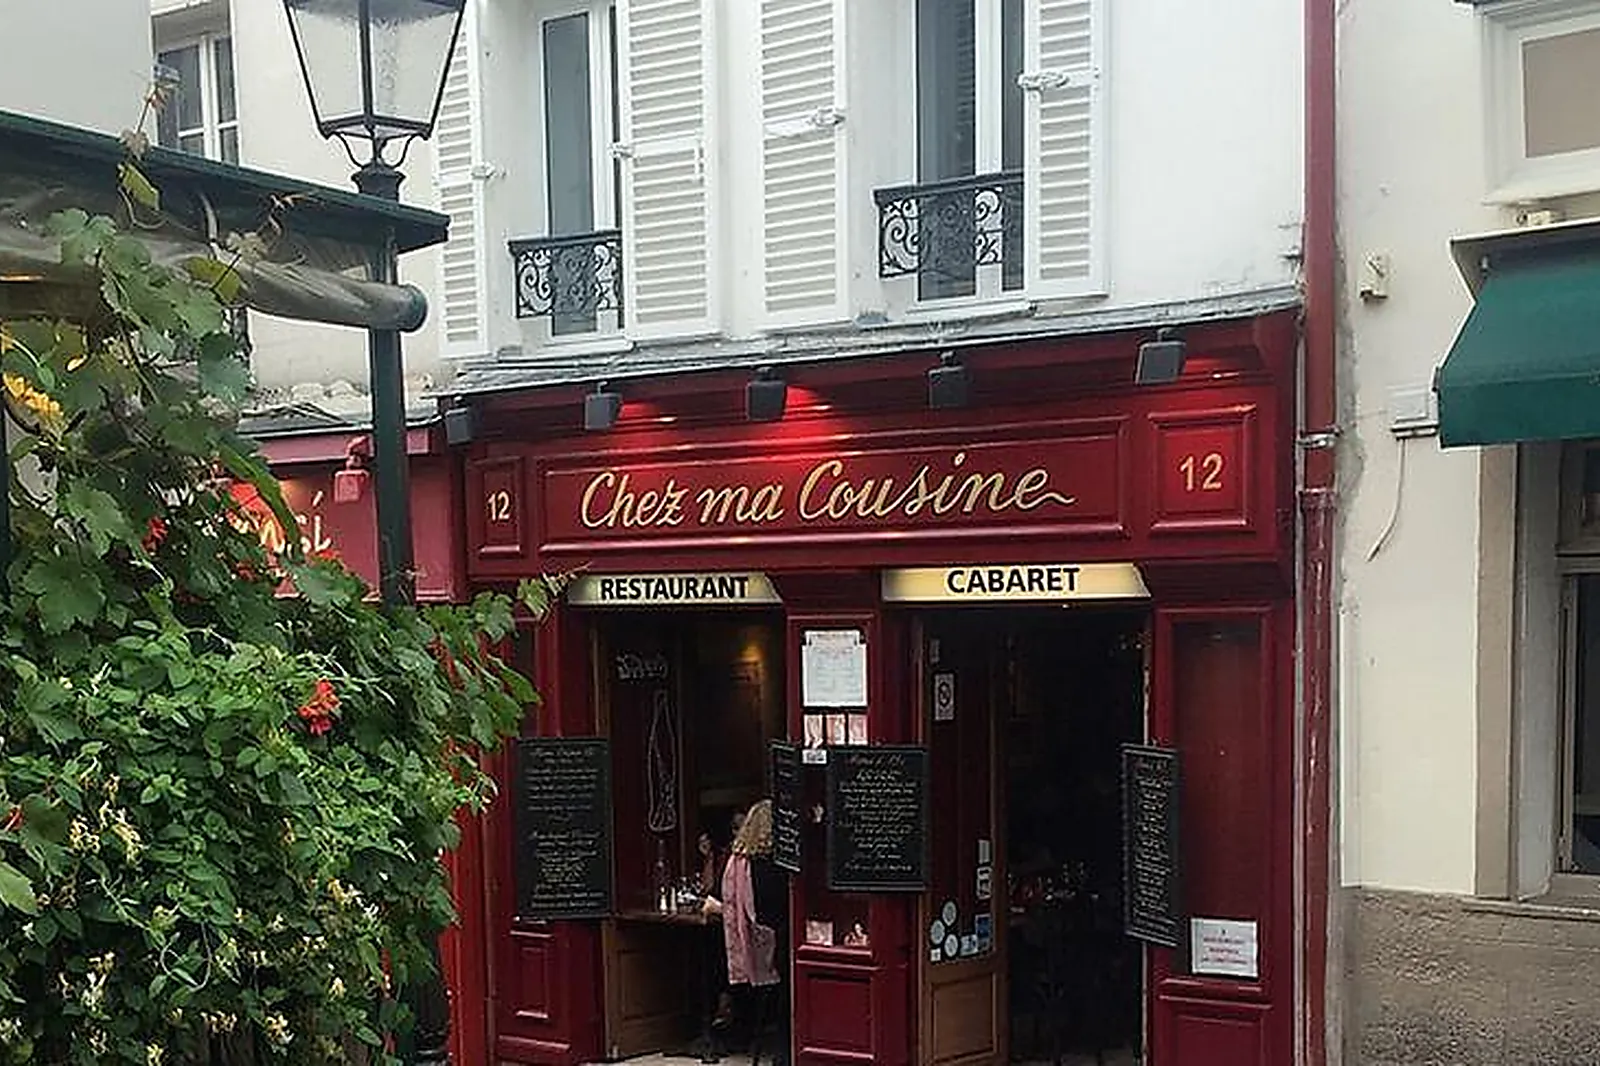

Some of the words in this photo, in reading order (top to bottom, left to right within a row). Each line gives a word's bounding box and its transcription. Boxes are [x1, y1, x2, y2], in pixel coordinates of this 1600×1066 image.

[1180, 453, 1223, 491] 12
[580, 471, 686, 528] Chez
[697, 485, 784, 525] ma
[798, 452, 1075, 520] Cousine
[488, 491, 510, 521] 12
[600, 576, 749, 600] RESTAURANT
[947, 567, 1081, 593] CABARET
